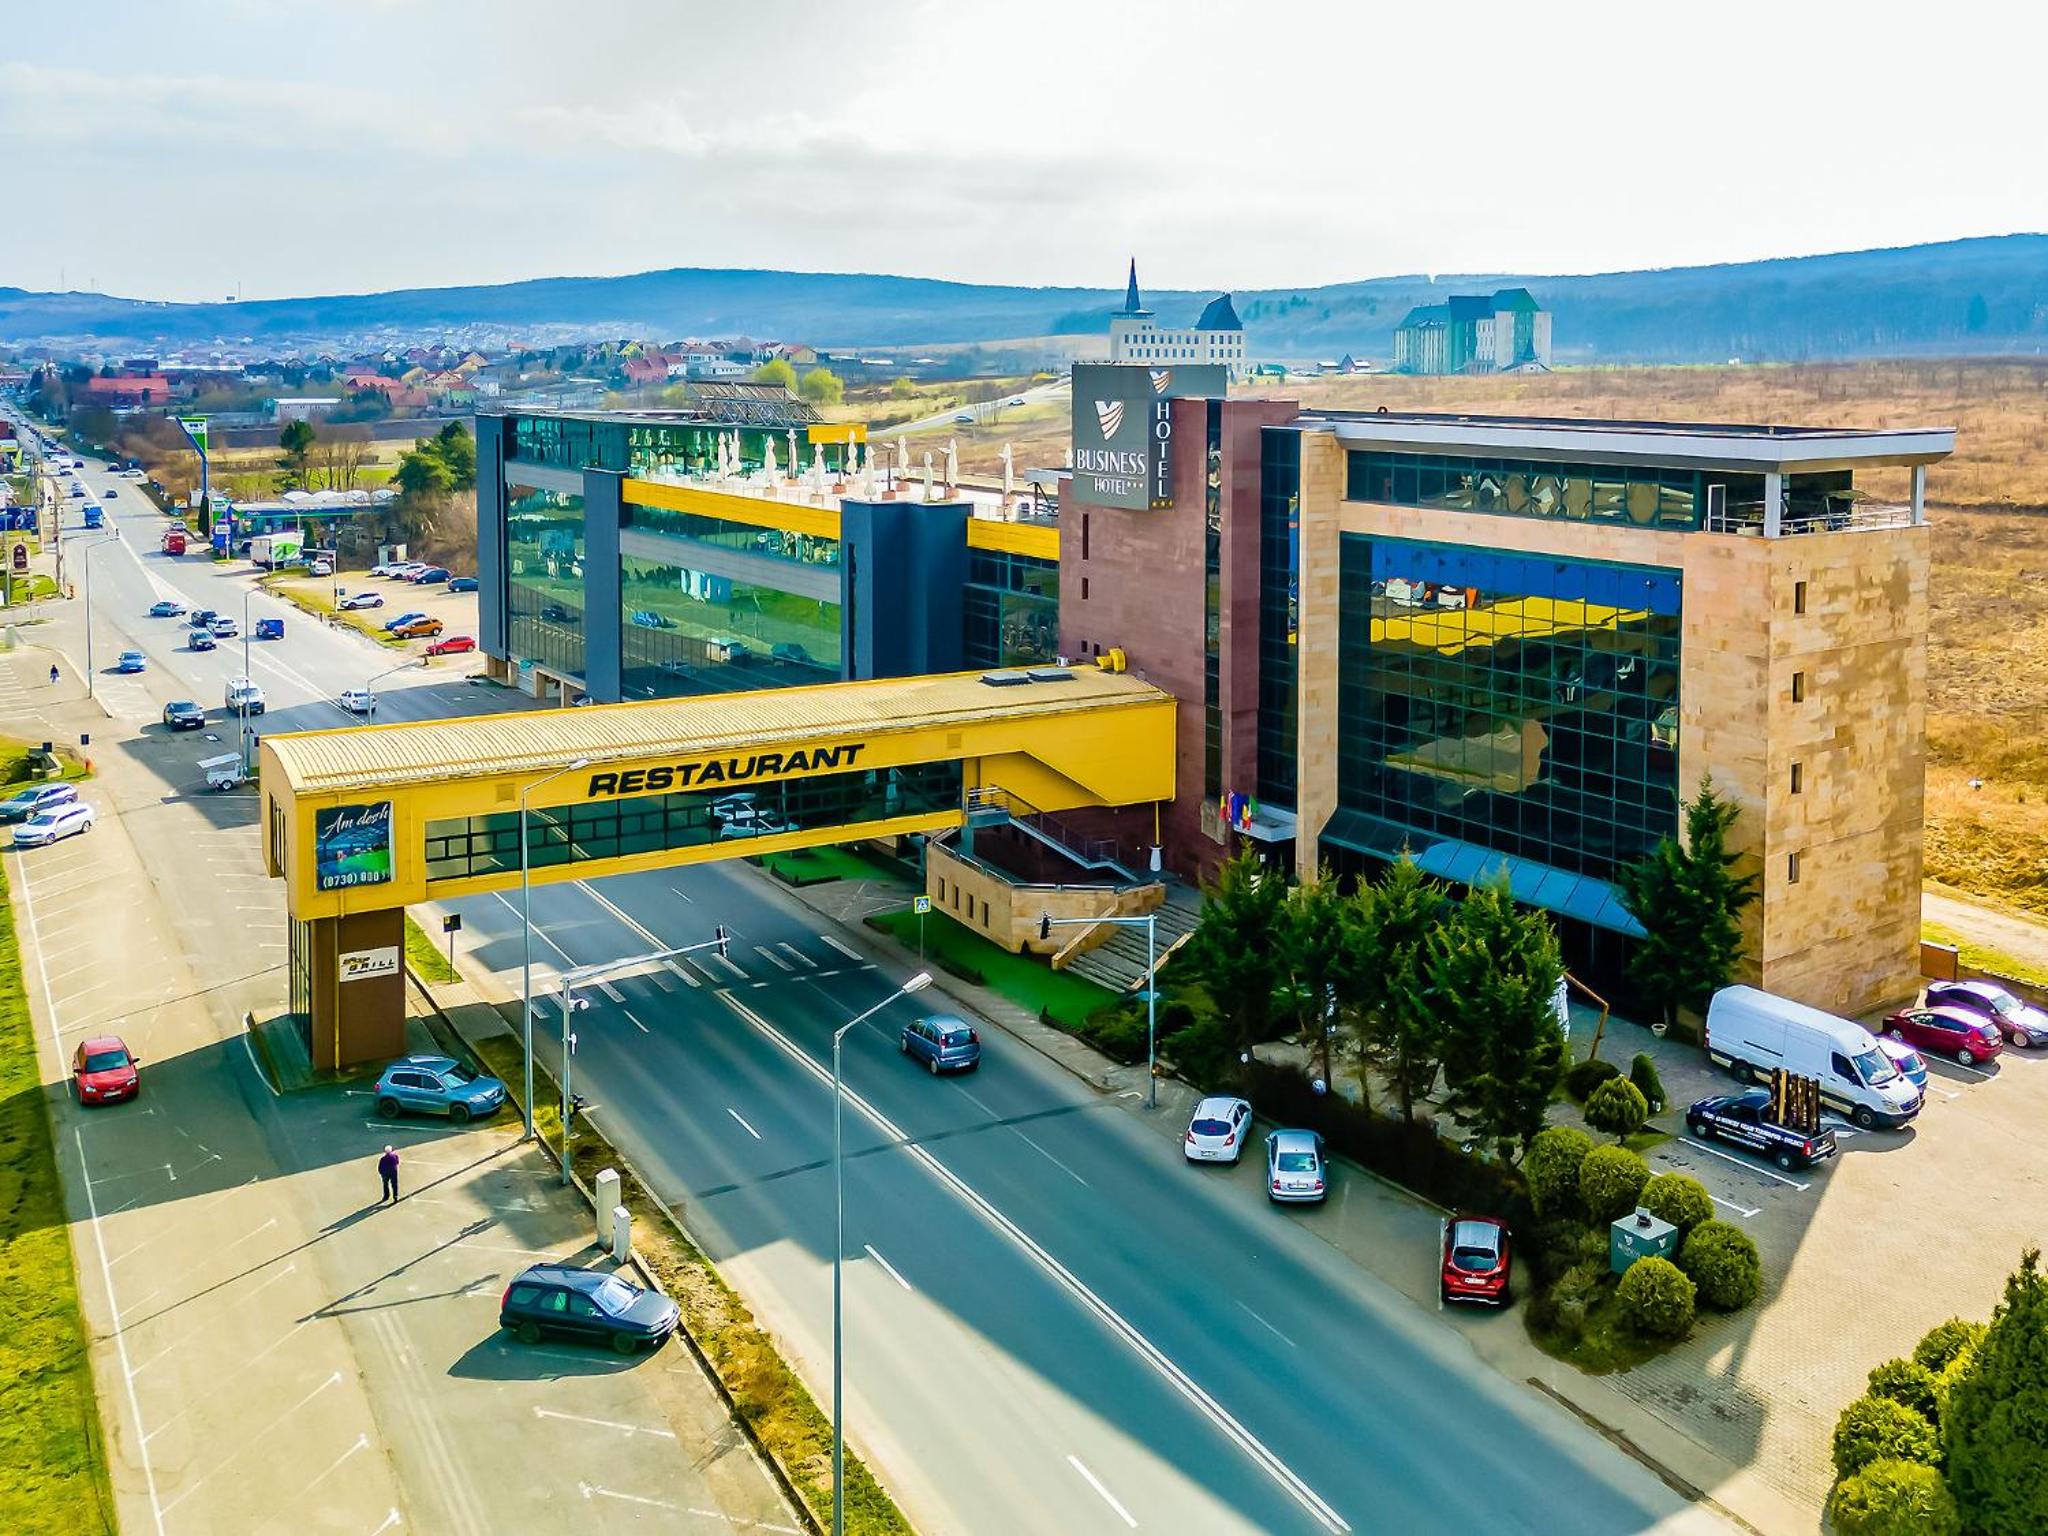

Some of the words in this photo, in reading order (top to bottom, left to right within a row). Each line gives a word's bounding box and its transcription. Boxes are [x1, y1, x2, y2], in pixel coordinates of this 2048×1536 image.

[1076, 448, 1146, 475] BUSINESS
[1156, 402, 1171, 498] HOTEL
[1094, 477, 1128, 495] HOTEL
[588, 743, 865, 798] RESTAURANT
[320, 812, 354, 839] Am
[323, 873, 358, 889] (0730)
